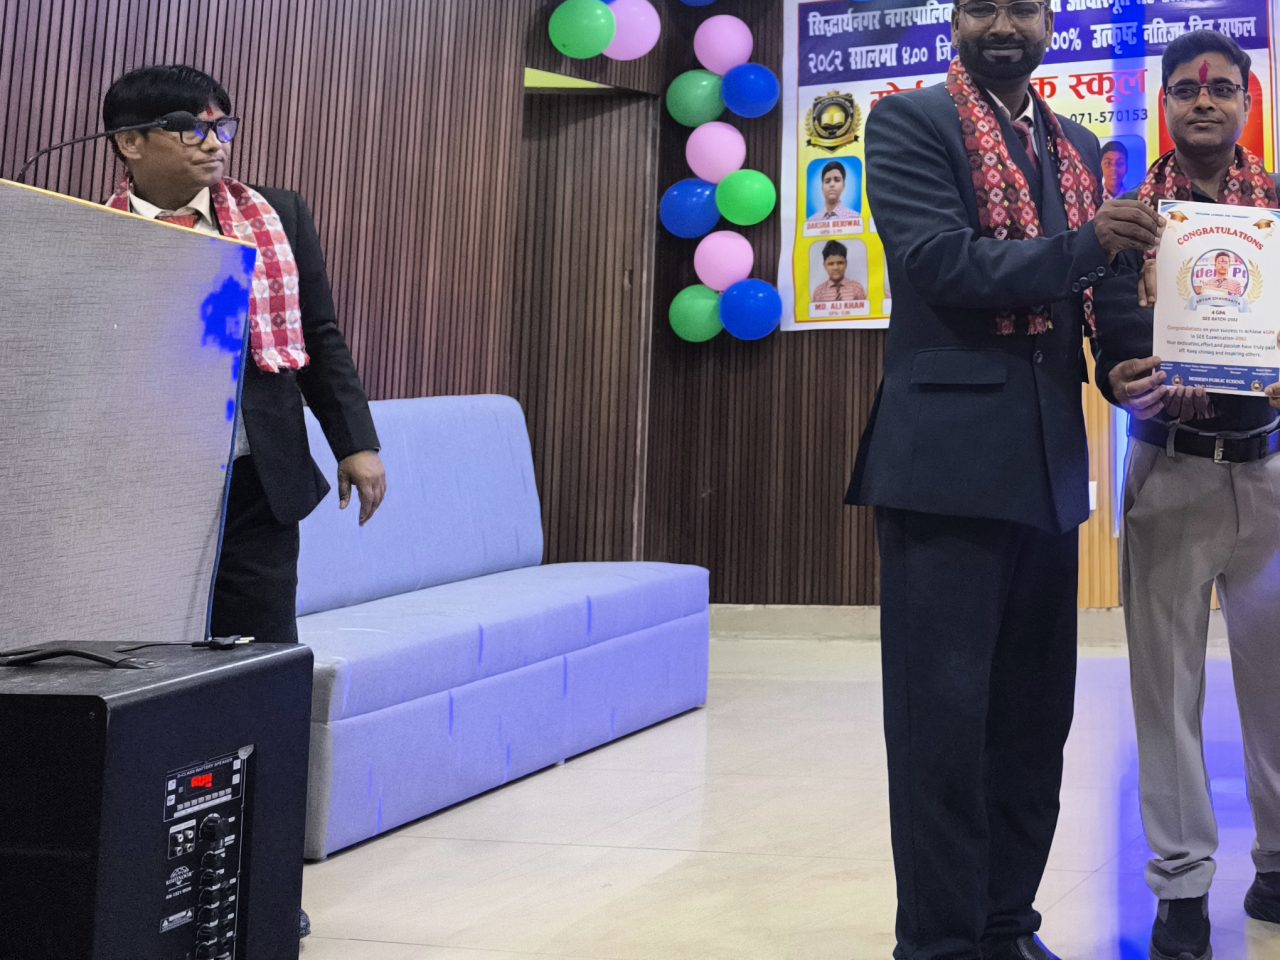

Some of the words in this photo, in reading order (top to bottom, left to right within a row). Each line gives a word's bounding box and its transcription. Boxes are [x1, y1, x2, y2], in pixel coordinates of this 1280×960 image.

[808, 7, 882, 37] सिद्धार्थनगर
[808, 50, 844, 74] २०८२
[848, 43, 898, 71] सालमा
[1048, 27, 1082, 52] ००%
[1090, 21, 1138, 55] उत्कृष्ट
[1218, 16, 1257, 38] सफल
[1068, 68, 1148, 104] स्कूल
[1070, 108, 1149, 124] 071-570153
[1176, 226, 1264, 251] CONGRATULATIONS
[844, 301, 865, 309] KHAN
